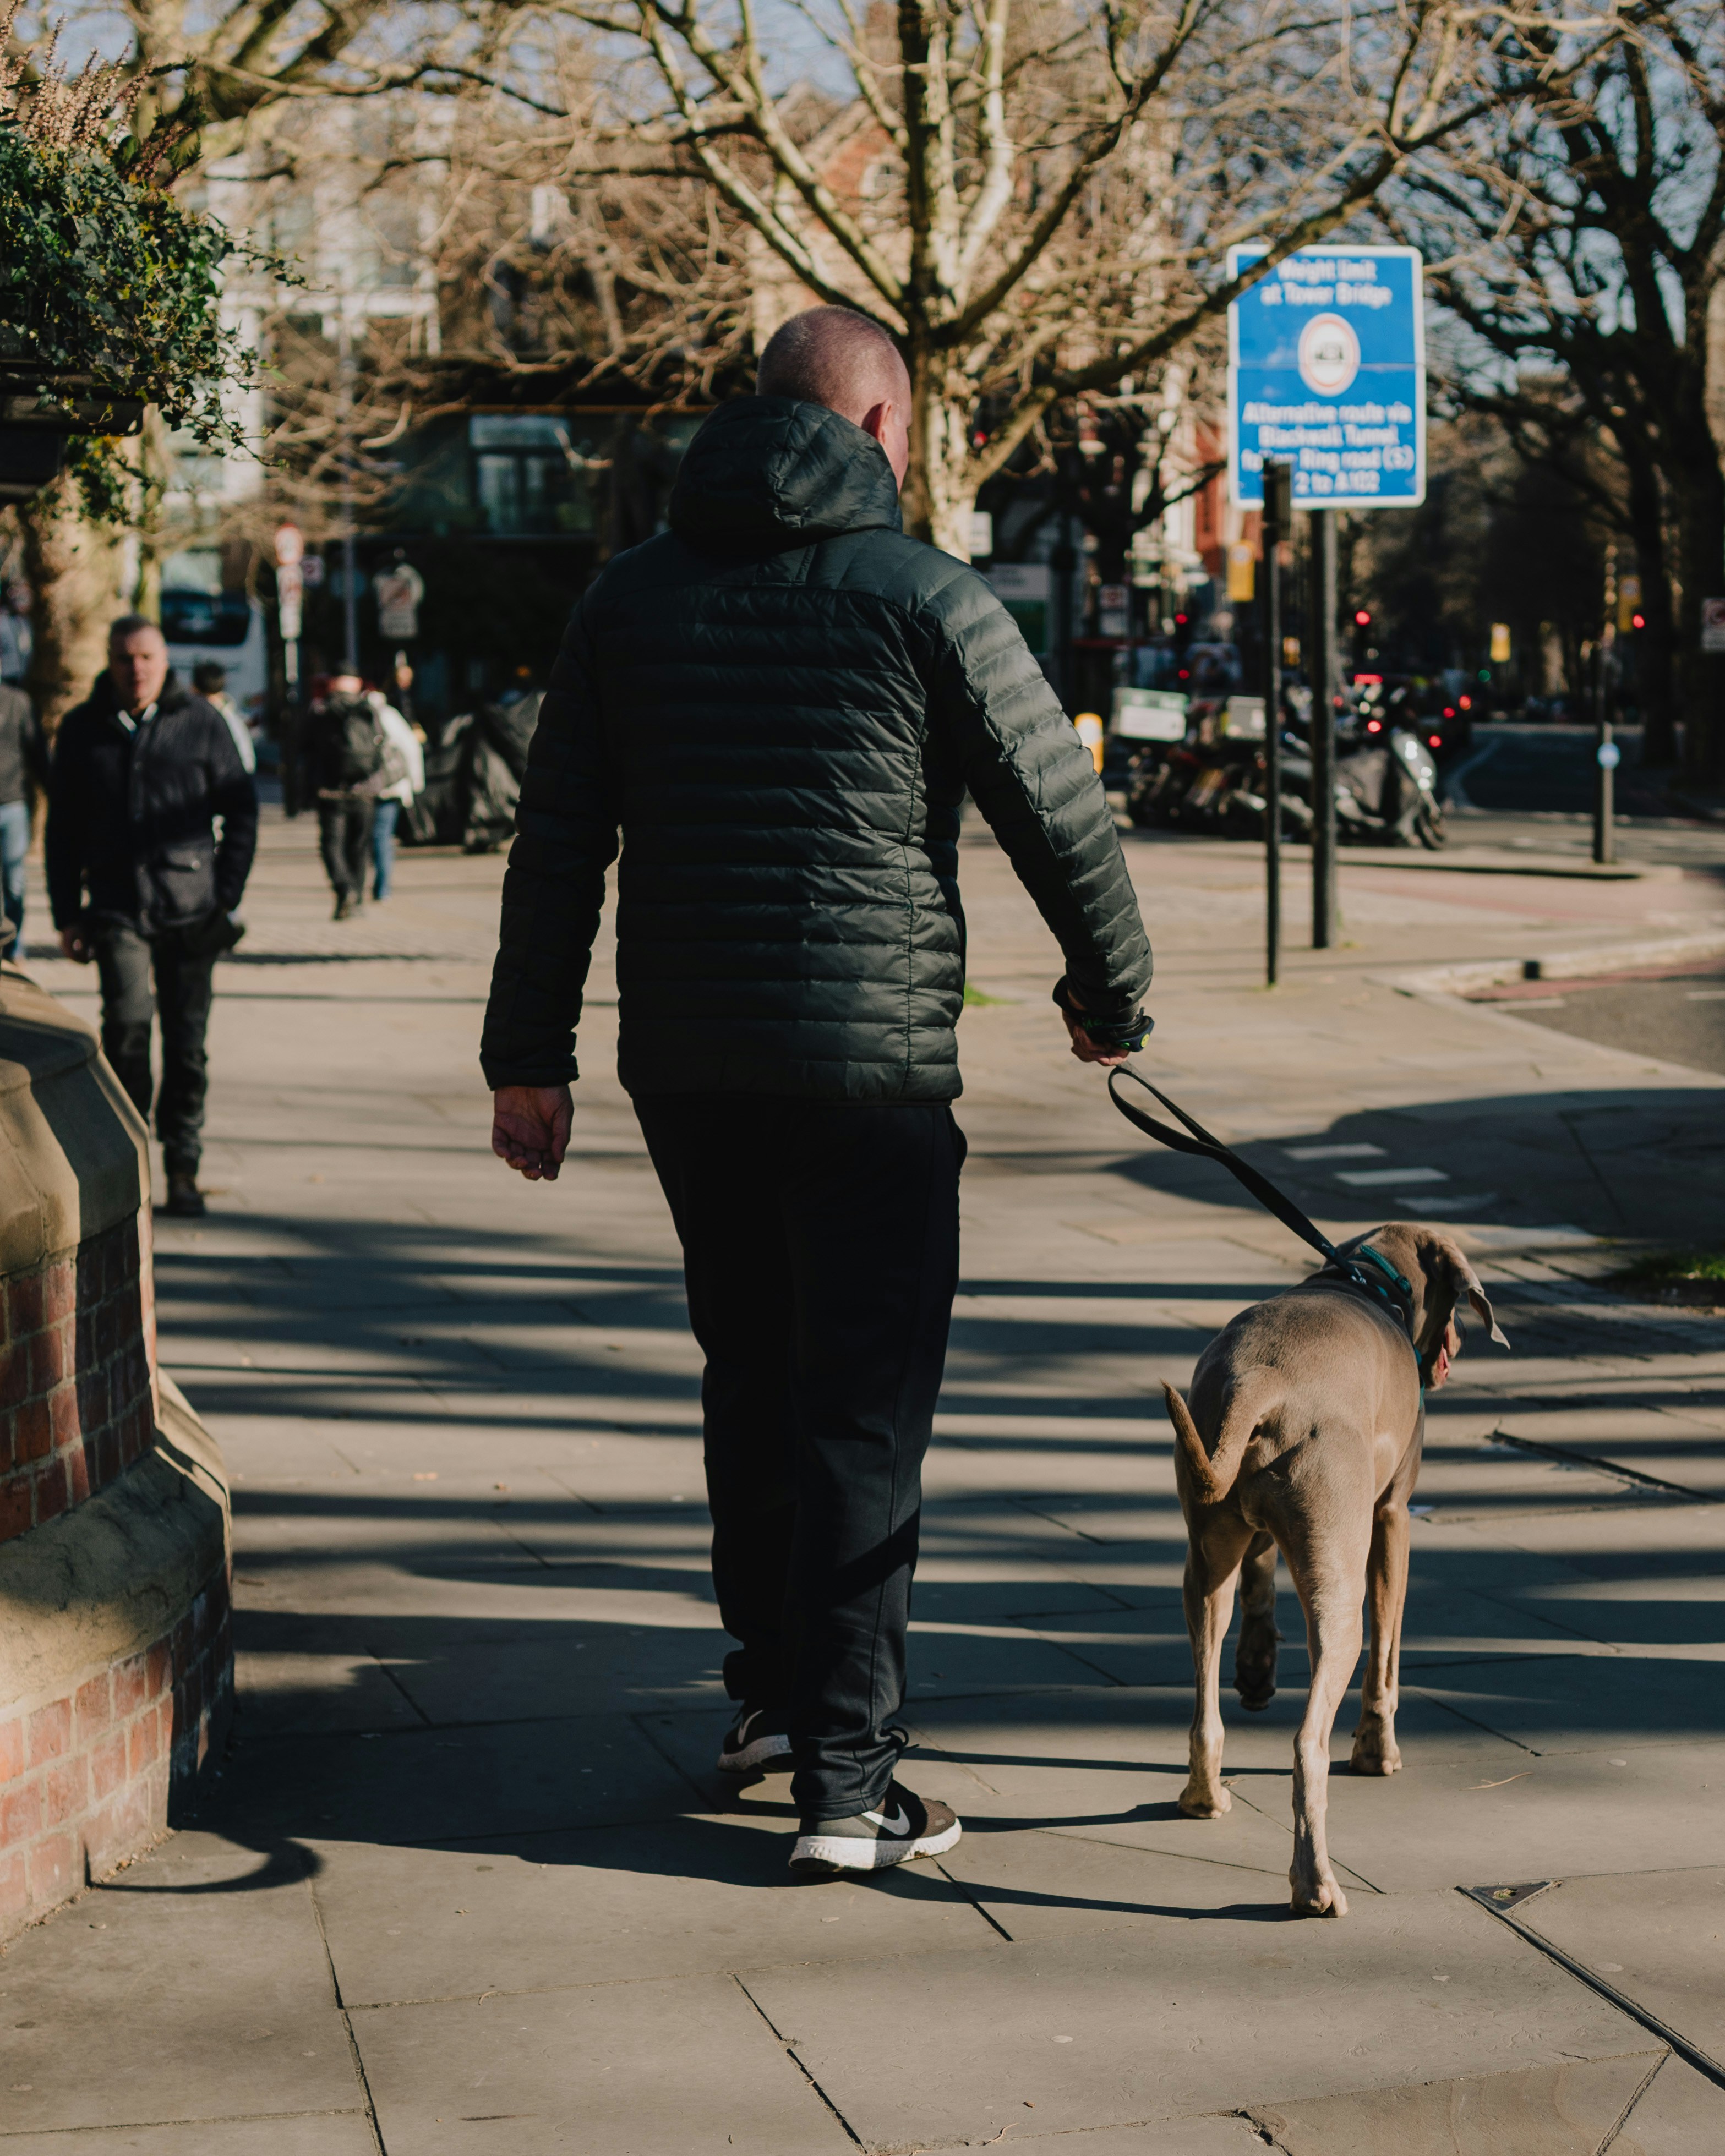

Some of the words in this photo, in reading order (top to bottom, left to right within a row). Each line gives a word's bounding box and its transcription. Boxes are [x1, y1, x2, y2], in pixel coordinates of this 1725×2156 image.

[1278, 258, 1335, 285] Weight
[1260, 283, 1282, 305] at
[1283, 282, 1333, 305] Tower
[1336, 282, 1393, 309] Bridge
[1242, 401, 1338, 424] Alternative
[1339, 401, 1385, 424] route
[1386, 401, 1412, 424] via
[1258, 425, 1344, 447] Blackwall
[1344, 424, 1399, 446] Tunnel
[1299, 448, 1339, 473] Ring
[1341, 448, 1381, 469] road
[1311, 472, 1333, 494] to
[1334, 470, 1380, 493] A102
